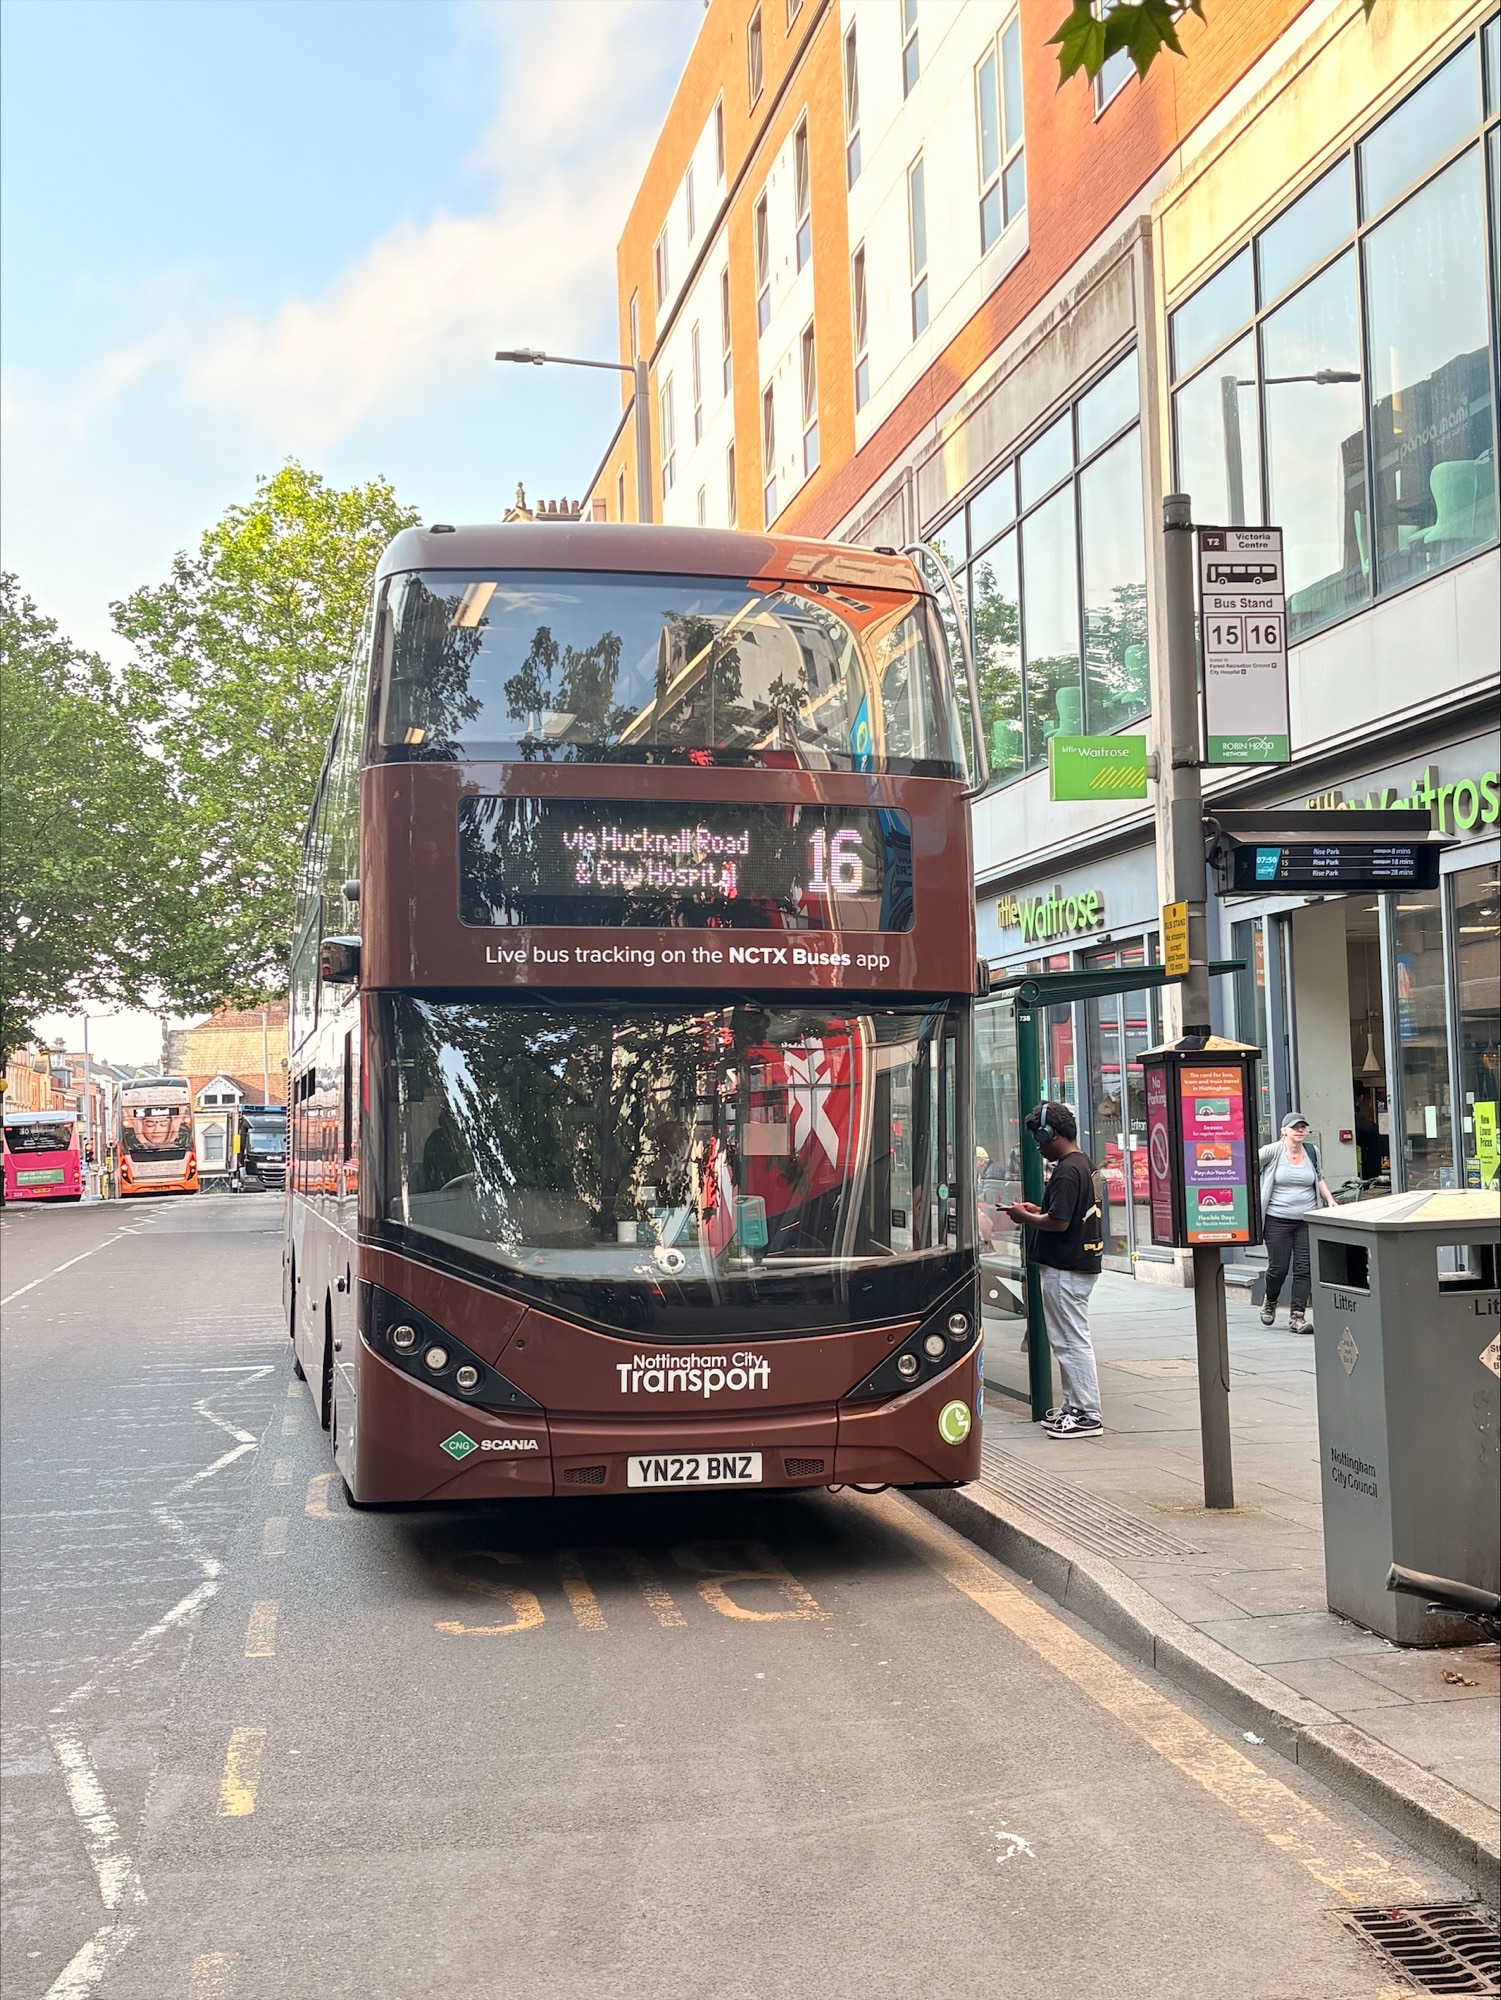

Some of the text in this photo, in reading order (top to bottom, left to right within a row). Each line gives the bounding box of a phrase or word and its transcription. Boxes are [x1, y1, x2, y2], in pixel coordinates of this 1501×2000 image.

[1207, 538, 1220, 546] T2
[1235, 533, 1271, 541] Victoria
[1238, 541, 1268, 549] Centre
[1214, 597, 1273, 608] Bus Stand
[1212, 625, 1238, 645] 15
[1251, 625, 1277, 645] 16
[1078, 747, 1130, 758] Waitrose
[1222, 742, 1275, 751] ROBIN HOOD
[563, 826, 749, 854] via Hucknall Road
[808, 829, 863, 893] 16
[1256, 856, 1277, 864] 07:50
[597, 860, 642, 885] City
[996, 884, 1100, 941] little Waitrose
[486, 946, 890, 971] Live bus tracking on the NCTX Buses app
[1152, 1077, 1160, 1089] No
[1148, 1092, 1167, 1107] Parking
[1333, 1293, 1357, 1313] Litter
[633, 1352, 764, 1373] Nottingham City
[616, 1360, 771, 1398] Transport
[448, 1441, 470, 1450] CNG
[480, 1439, 539, 1451] SCANIA
[638, 1456, 752, 1482] YN22 BNZ
[1331, 1448, 1376, 1478] Nottingham
[1332, 1467, 1378, 1498] City Council
